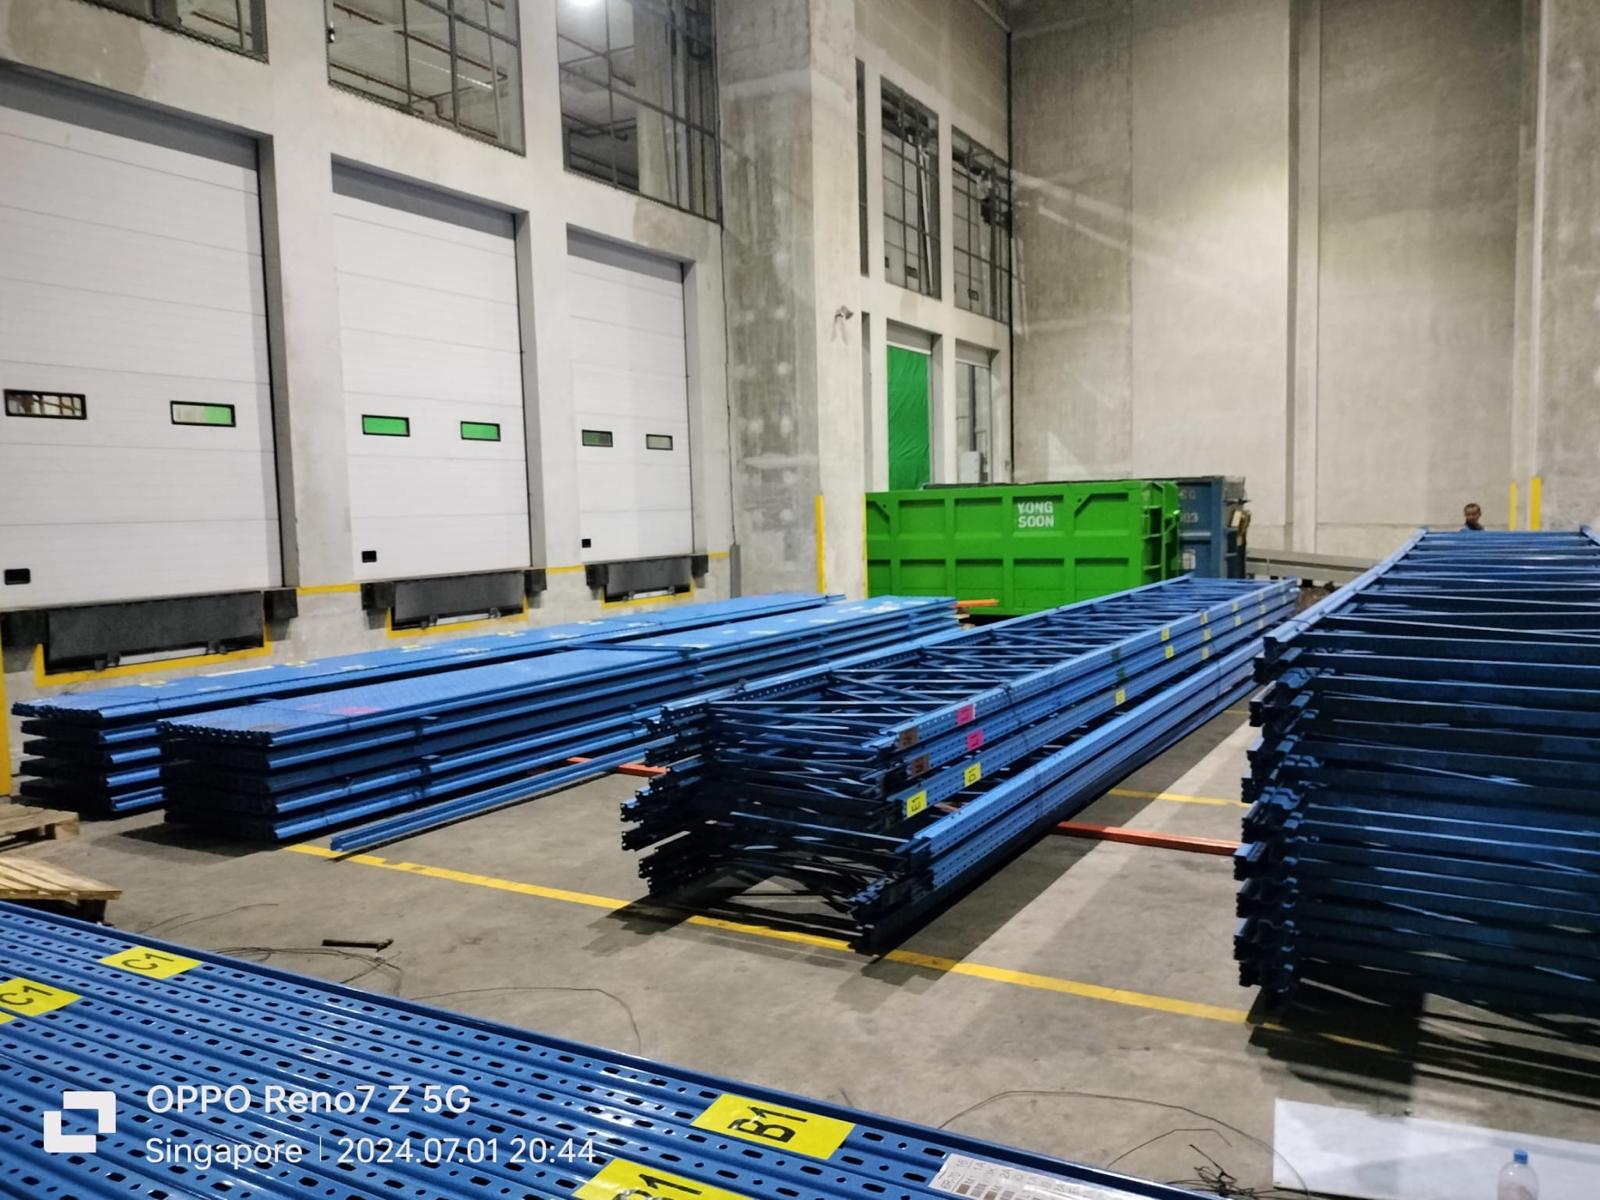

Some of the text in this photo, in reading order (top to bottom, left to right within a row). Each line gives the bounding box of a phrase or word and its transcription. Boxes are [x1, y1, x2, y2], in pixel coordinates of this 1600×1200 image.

[1017, 501, 1054, 514] YONG
[1018, 515, 1055, 528] SOON
[121, 952, 175, 971] C1
[0, 985, 54, 1006] C1
[726, 1105, 808, 1144] B1
